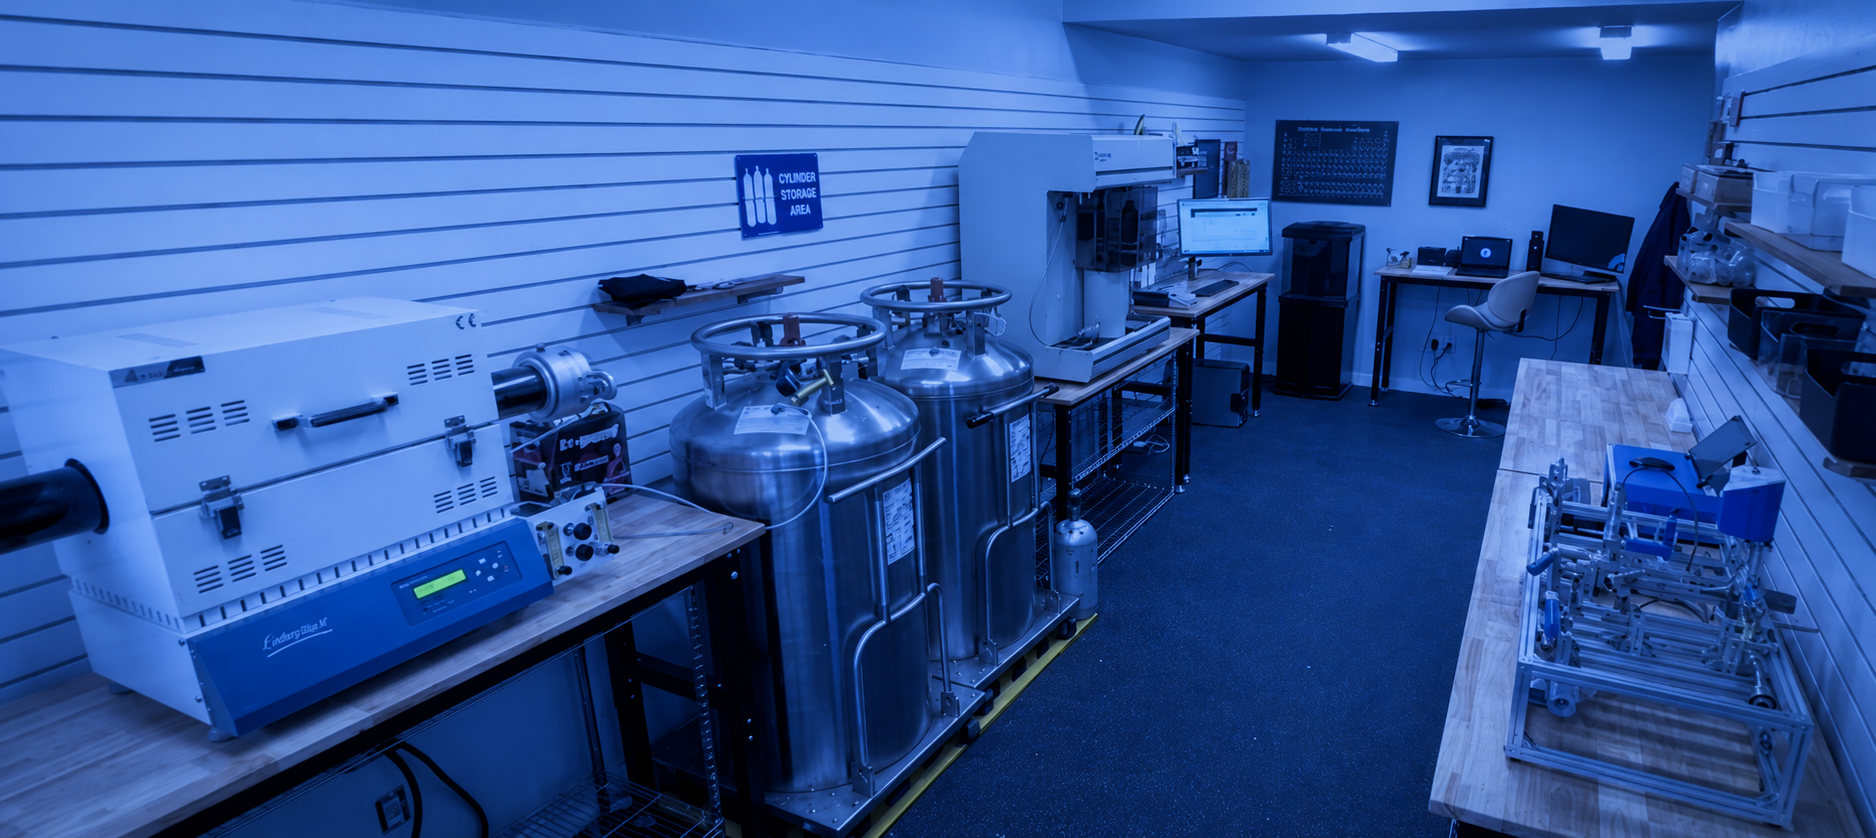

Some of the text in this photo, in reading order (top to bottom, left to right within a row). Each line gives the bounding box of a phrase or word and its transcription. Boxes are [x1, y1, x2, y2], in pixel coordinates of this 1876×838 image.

[778, 171, 817, 184] CYLINDER
[780, 187, 817, 201] STORAGE
[789, 204, 811, 216] AREA
